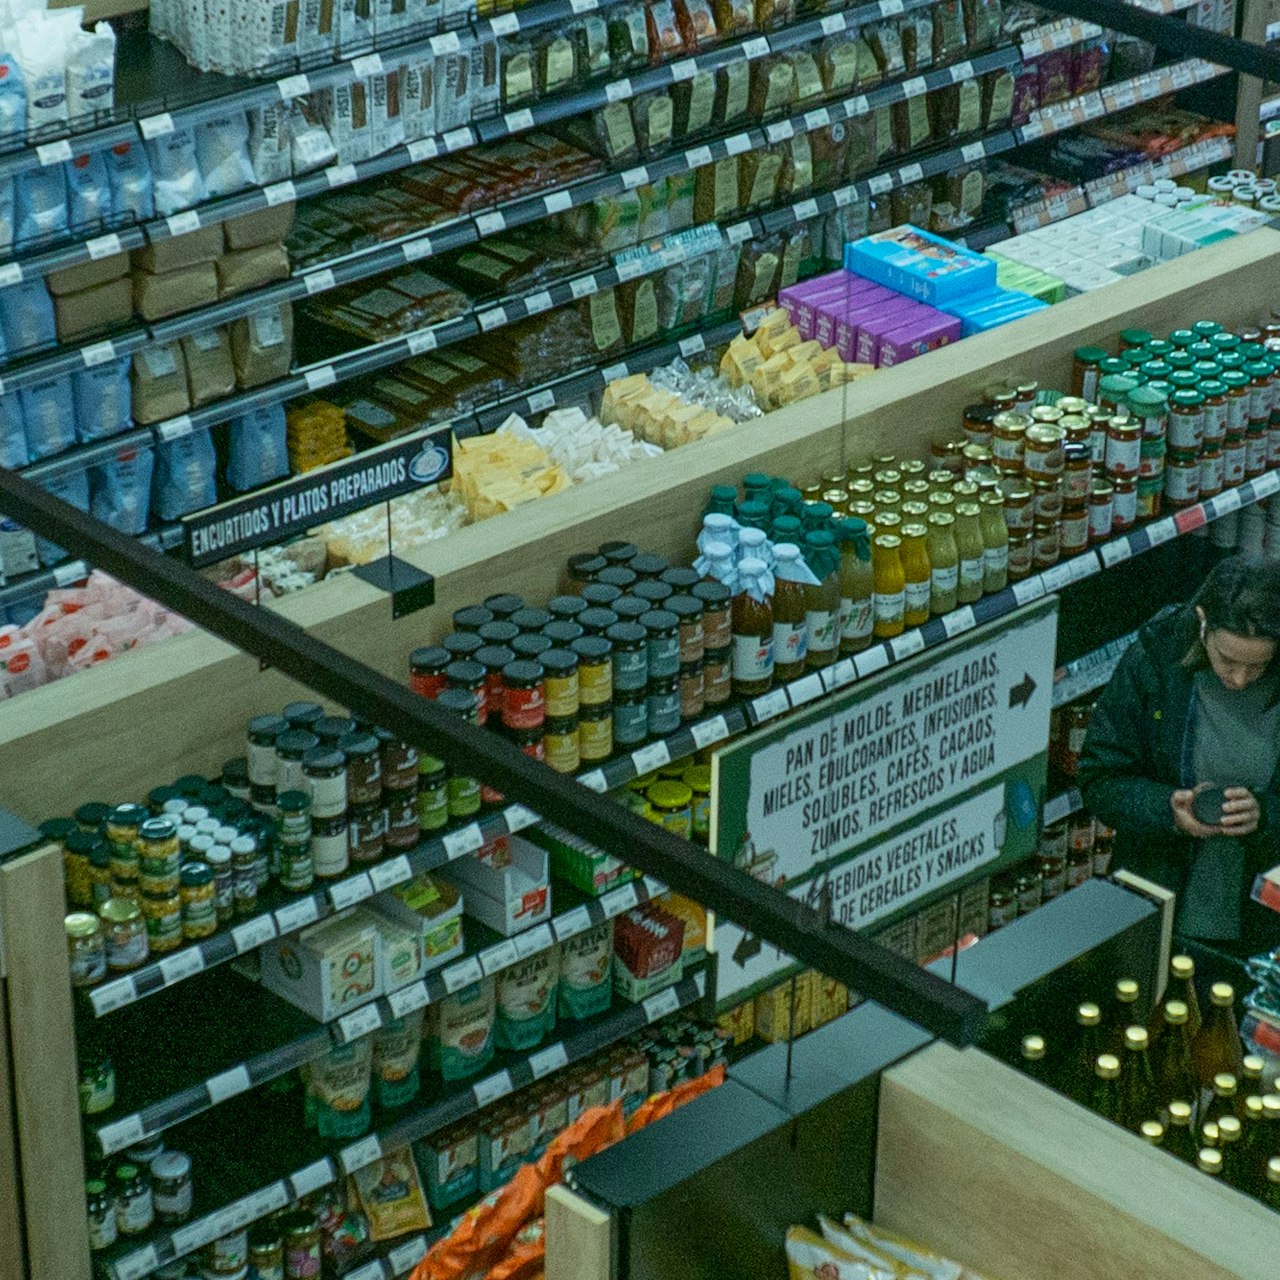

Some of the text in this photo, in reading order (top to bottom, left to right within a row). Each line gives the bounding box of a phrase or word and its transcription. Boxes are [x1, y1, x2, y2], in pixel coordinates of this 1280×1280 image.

[191, 456, 406, 557] ENCURTIDOS Y PLATOS PREPARADOS
[763, 683, 998, 818] MIELES, EDULCORANTES, INFUSIONES,
[786, 652, 1000, 775] PAN DE MOLDE, MERMELADAS,
[801, 715, 996, 829] SOLUBLES, CAFÉS, CACAOS,
[811, 742, 996, 857] ZUMOS, REFRESCOS Y AGUA
[839, 832, 985, 926] DE CEREALES Y SNACKS
[886, 818, 959, 872] VEGETALES,
